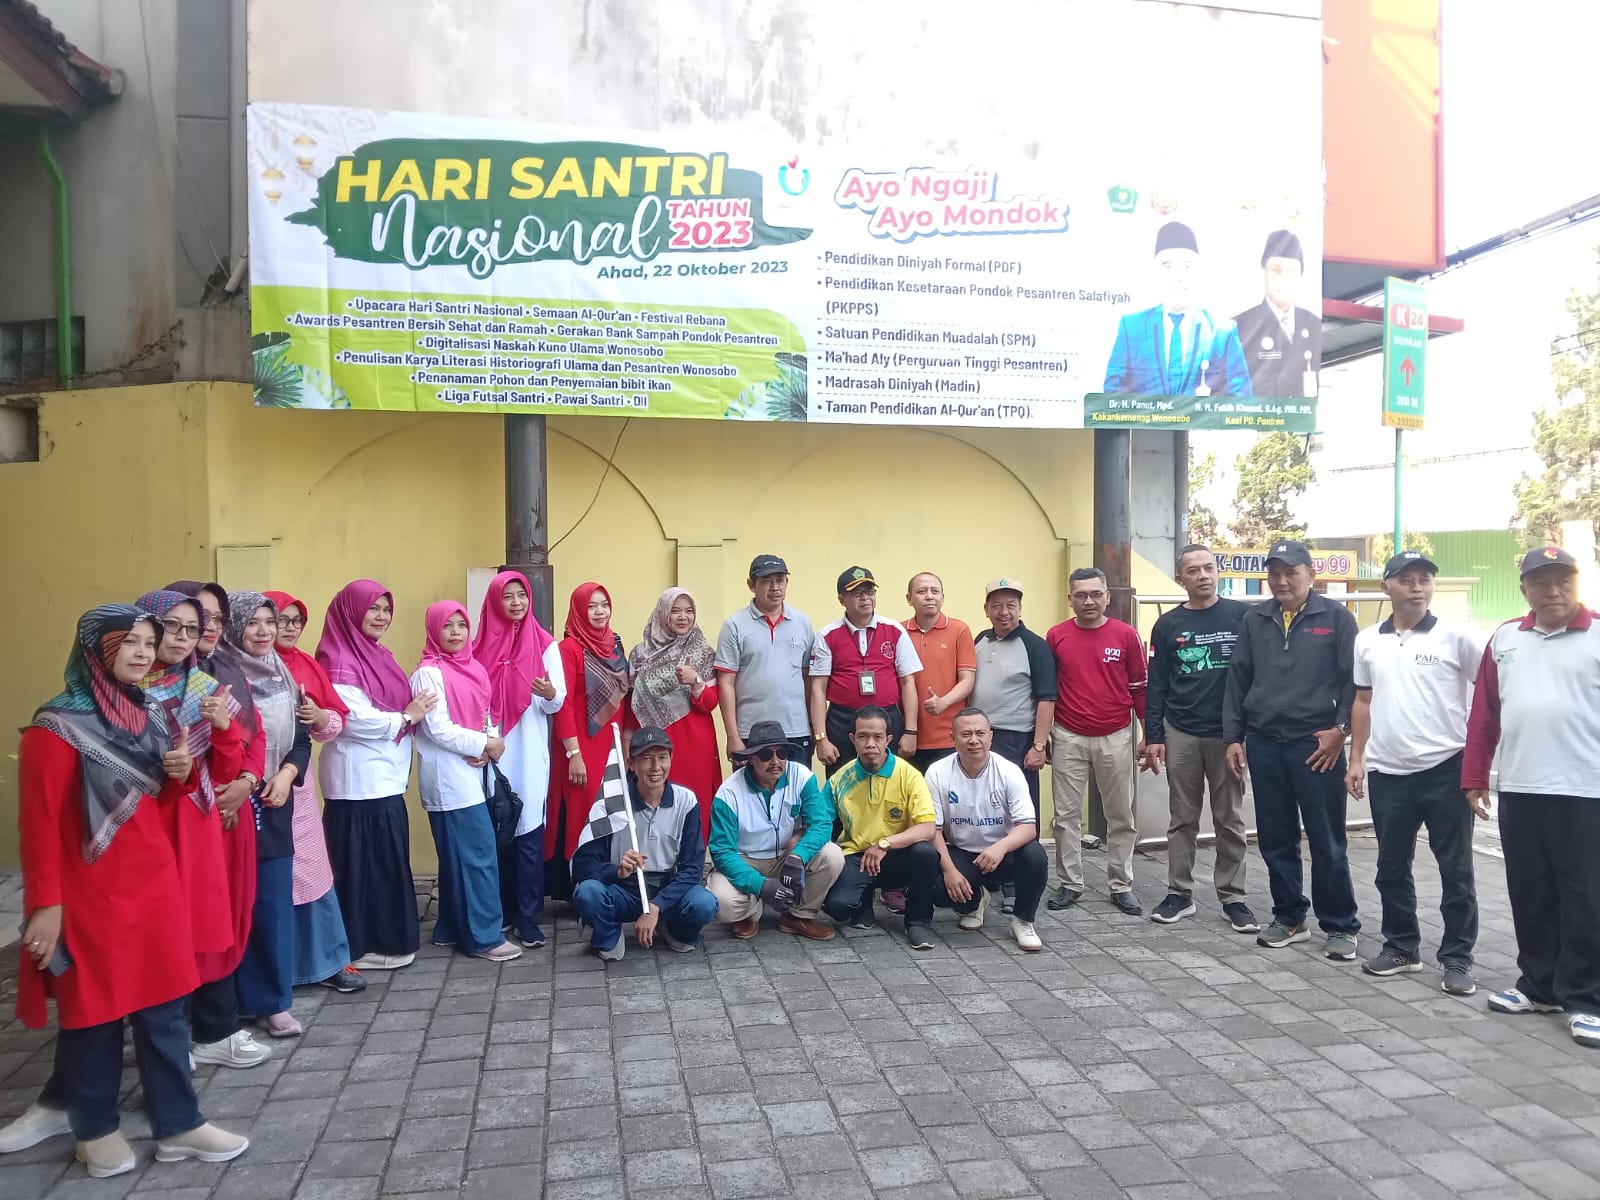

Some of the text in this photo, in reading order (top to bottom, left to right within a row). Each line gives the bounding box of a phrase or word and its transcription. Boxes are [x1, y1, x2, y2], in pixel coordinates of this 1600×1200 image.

[336, 155, 724, 202] HARI SANTRI
[842, 172, 988, 203] Ayo Ngaji
[668, 202, 748, 218] TAHUN
[876, 202, 1058, 233] Ayo Mondok
[371, 194, 661, 275] Nasional
[671, 220, 750, 246] 2023
[597, 261, 788, 280] Ahad, 22 Oktober 2023
[825, 251, 1022, 274] Pendidikan Diniyah Formal (PDF)
[826, 276, 1130, 304] Pendidikan Kesetaraan Pondok Pesantren Salafiyah
[356, 299, 726, 326] Upacara Hari Santri Nasional Semaan Al-Qur'an Festival Rebana
[826, 300, 879, 316] (PKPPS)
[1397, 305, 1424, 326] K 24
[295, 314, 778, 345] Awards Pesantren Bersih Sehat dan Ramah Gerakan Bank Sampah Pondok Pesantren
[826, 326, 1036, 348] Satuan Pendidikan Muadalah (SPM)
[426, 337, 664, 356] Digitalisasi Naskah Kuno Ulama Wonosobo
[344, 352, 736, 376] Penulisan Karya Literasi Historiografi Ulama dan Pesantren Wonosobo
[826, 350, 1068, 372] Ma'had Aly (Perguruan Tinggi Pesantren)
[418, 372, 671, 391] Penanaman Pohon dan Penyemaian bibit ikan
[826, 376, 980, 393] Madrasah Diniyah (Madin)
[445, 390, 470, 404] Liga
[473, 391, 507, 403] Futsal
[510, 392, 544, 404] Santri
[555, 394, 588, 405] Pawai
[591, 394, 624, 406] Santri
[1109, 400, 1120, 408] Dr.
[1122, 400, 1130, 409] H.
[826, 400, 866, 413] Taman
[870, 402, 936, 416] Pendidikan
[940, 404, 994, 418] Al-Qur'an
[1152, 414, 1190, 424] Wonosobo
[1330, 557, 1348, 572] 99
[1416, 653, 1440, 663] PAIS
[976, 816, 1004, 826] JATENG
